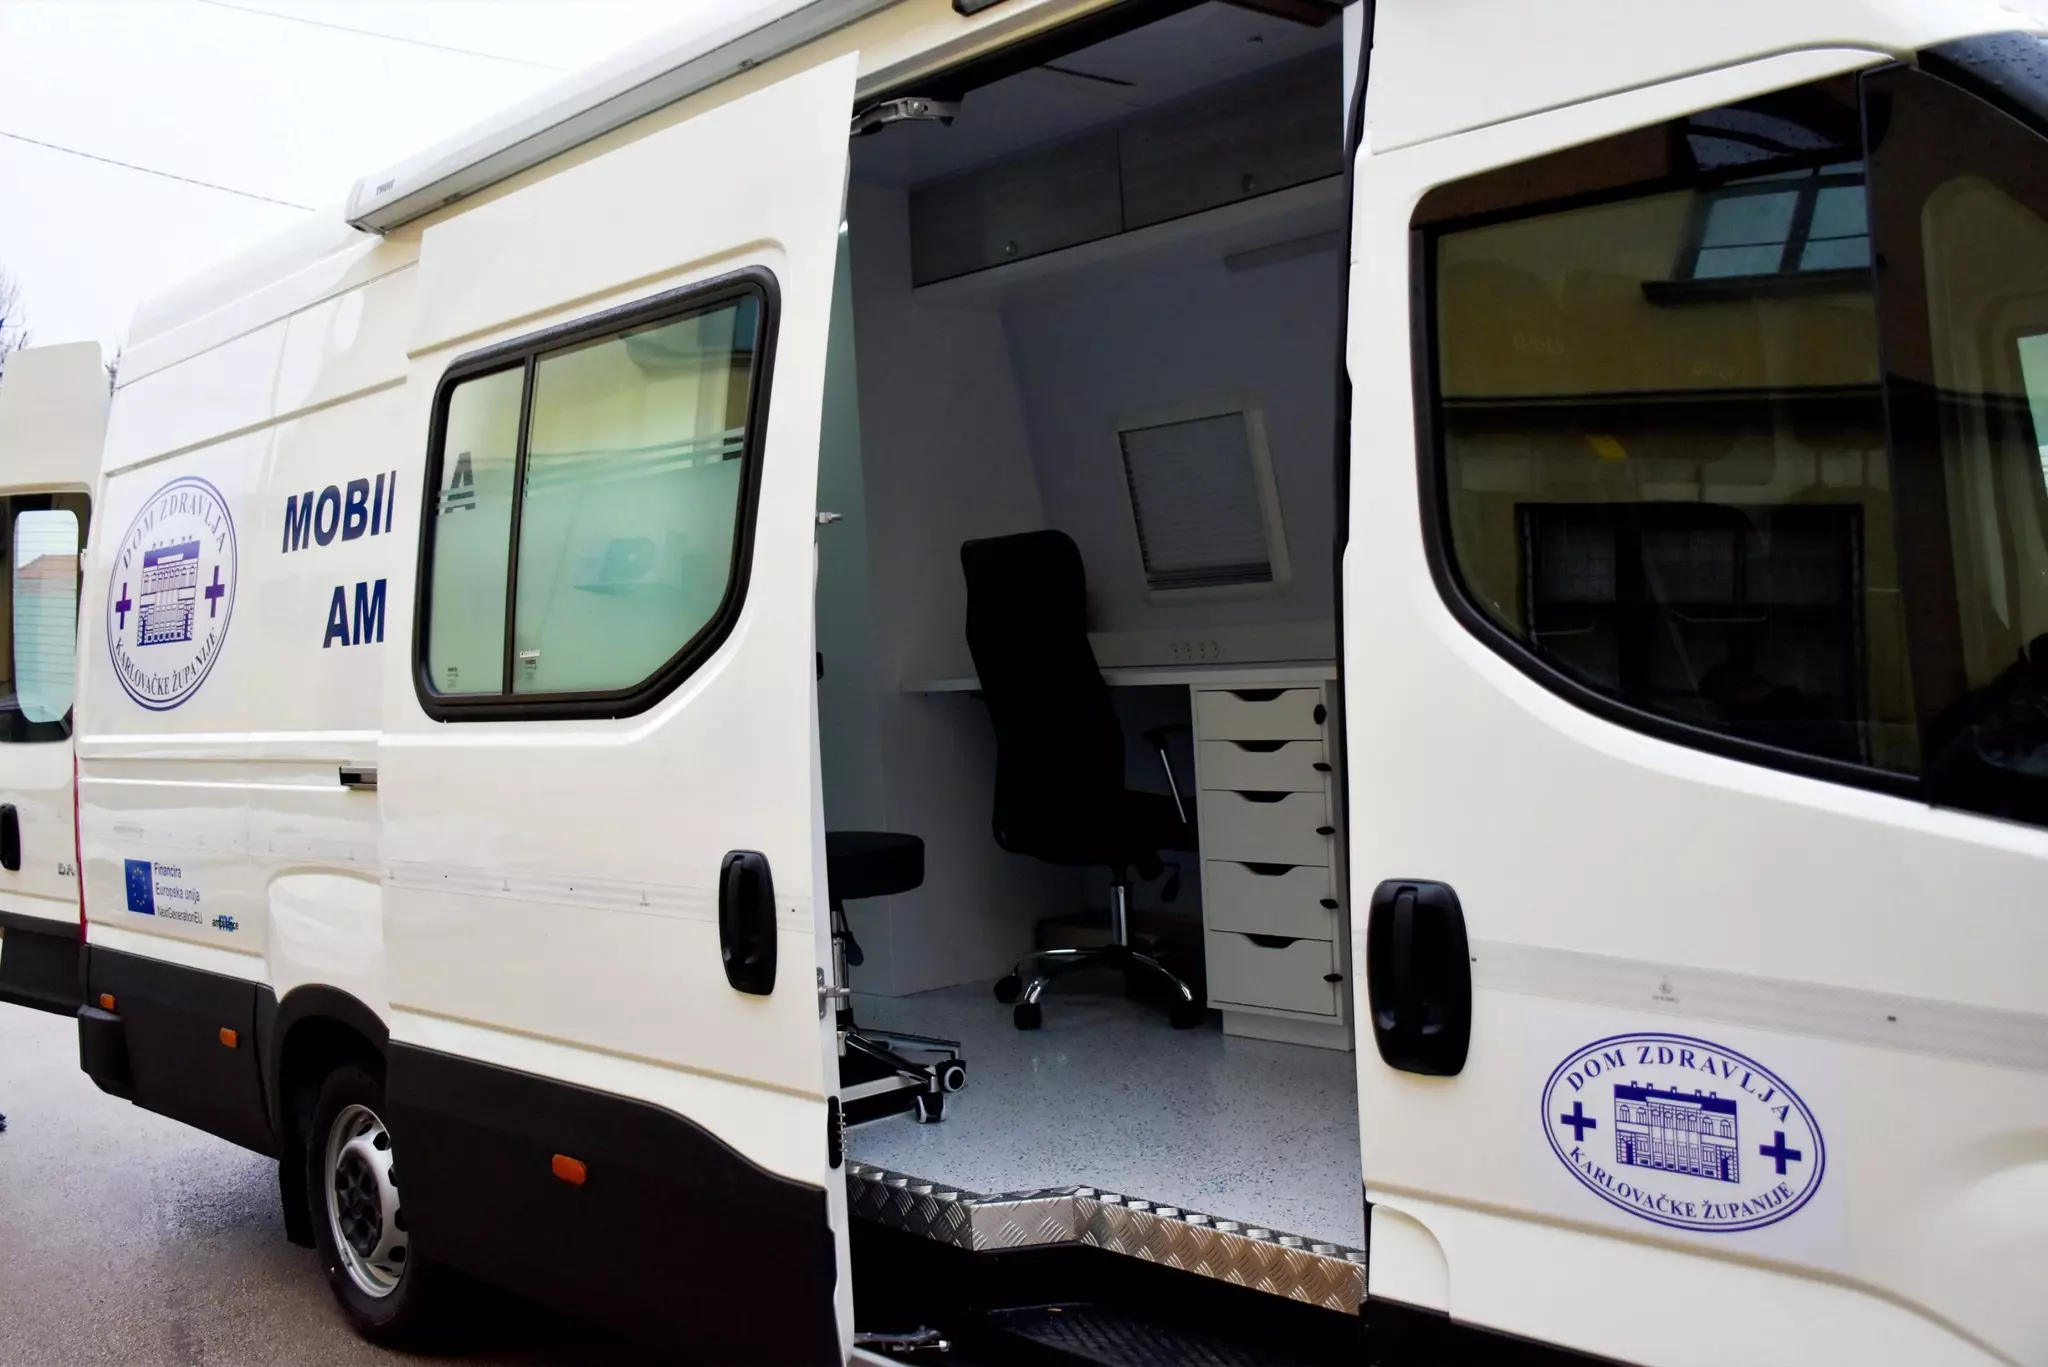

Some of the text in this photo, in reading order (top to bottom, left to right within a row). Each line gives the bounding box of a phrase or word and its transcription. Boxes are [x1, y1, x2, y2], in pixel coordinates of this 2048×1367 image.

[122, 491, 227, 570] DOM ZDRAVLJA
[322, 578, 388, 649] AM
[115, 626, 219, 697] KARLOVAČKE ŽUPANIJE
[154, 862, 182, 879] Financira
[155, 882, 200, 904] Europska unija
[1565, 1045, 1791, 1124] DOM ZDRAVLJA
[1569, 1146, 1795, 1220] KARLOVAČKE ŽUPANIJE
